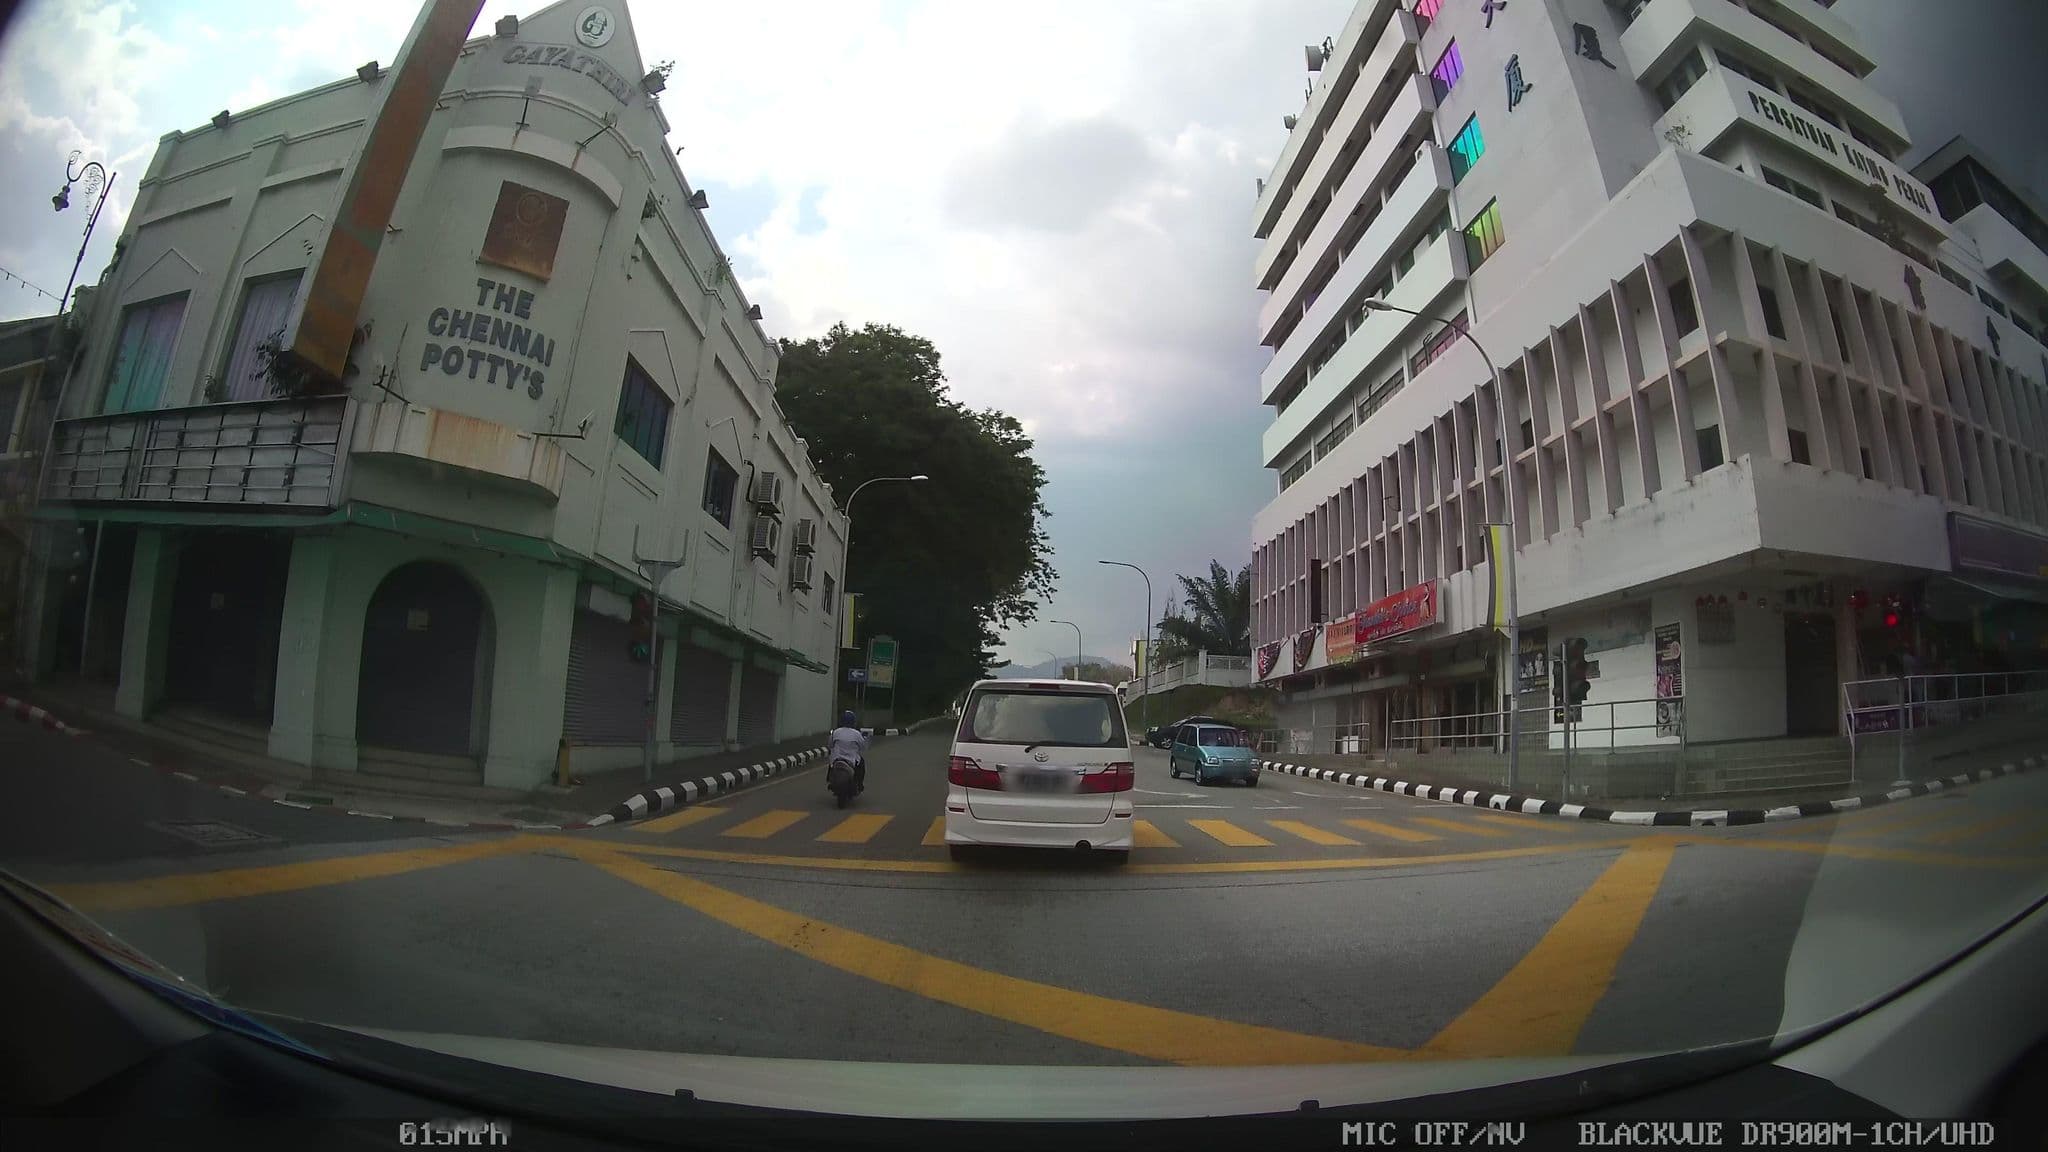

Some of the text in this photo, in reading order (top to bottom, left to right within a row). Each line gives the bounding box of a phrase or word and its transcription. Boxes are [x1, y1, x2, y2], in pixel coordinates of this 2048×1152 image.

[1748, 90, 1838, 156] PERSATUAN
[1893, 174, 1931, 214] PERAK
[477, 278, 535, 320] THE
[428, 307, 555, 367] CHENNAI
[420, 343, 545, 400] POTTY'S
